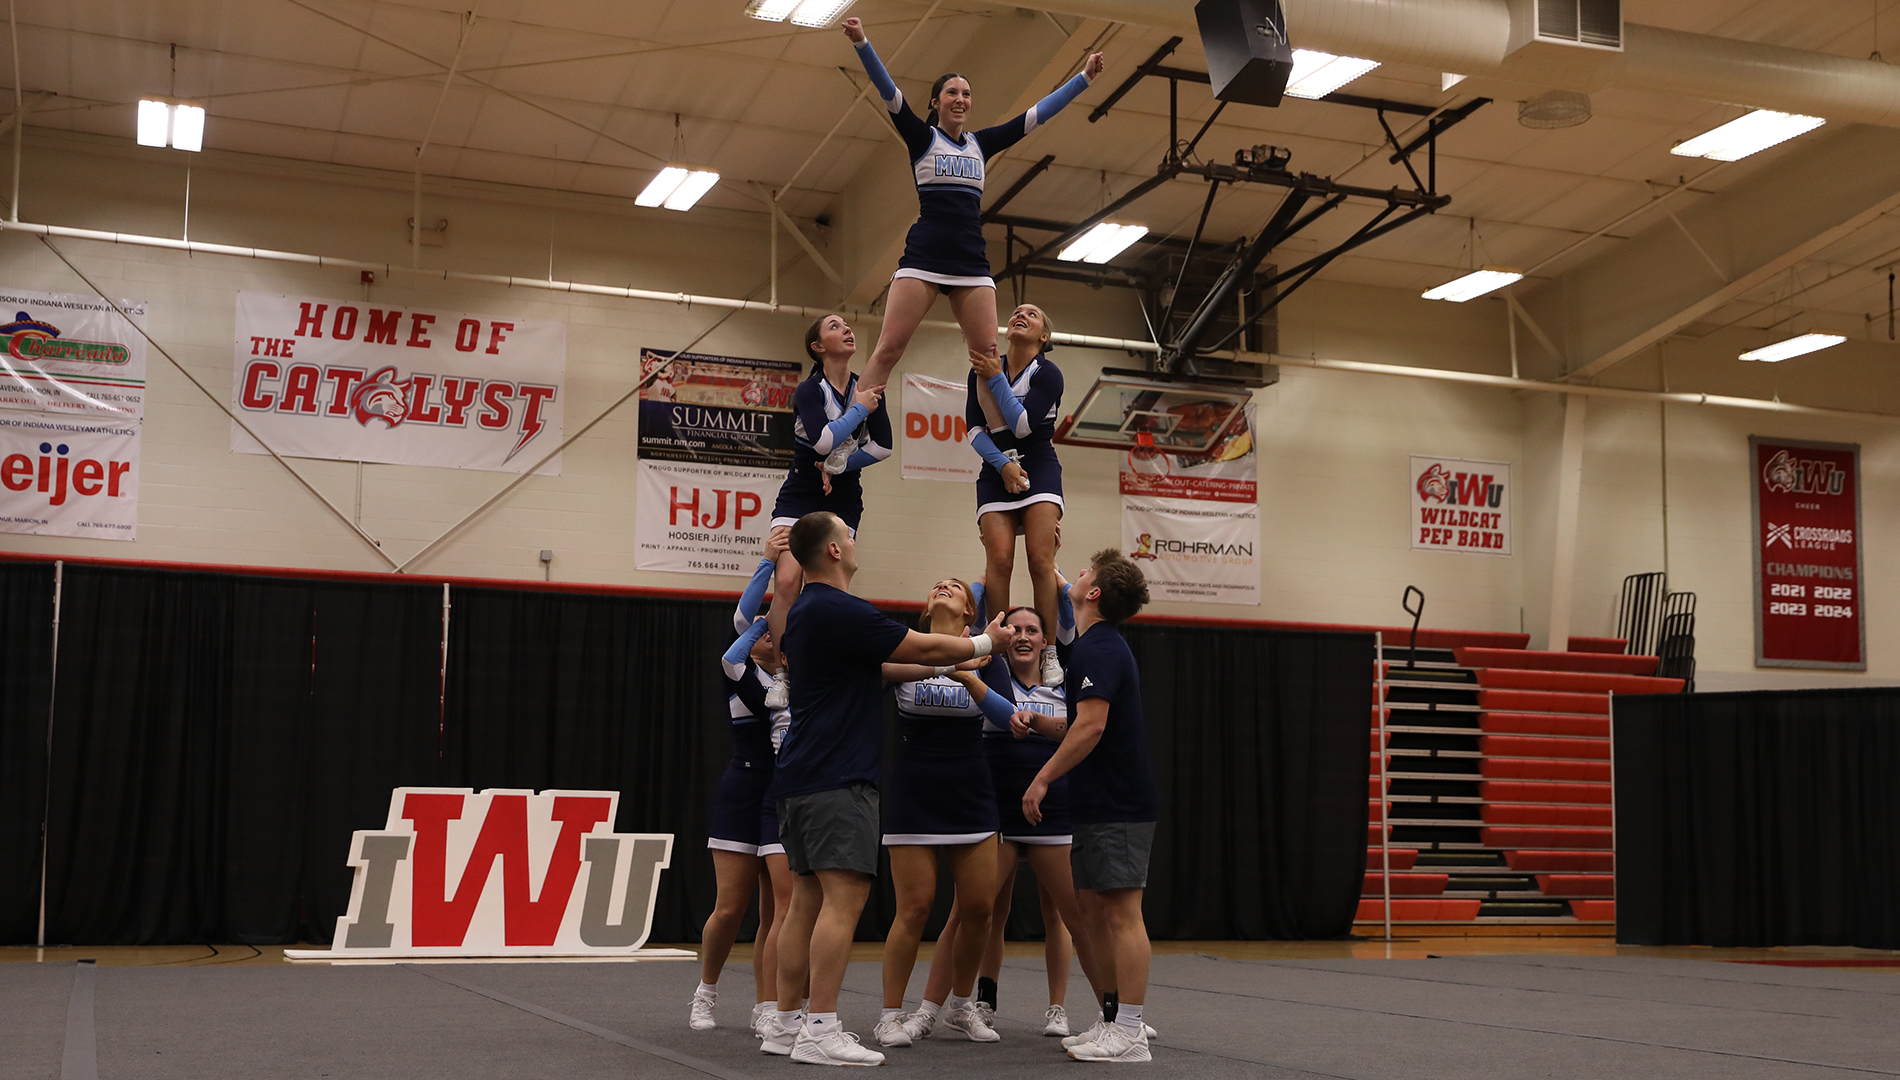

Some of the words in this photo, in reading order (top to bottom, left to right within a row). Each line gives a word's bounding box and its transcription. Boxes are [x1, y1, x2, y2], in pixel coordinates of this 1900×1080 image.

[935, 155, 982, 180] MVNU
[0, 295, 17, 303] SOR
[18, 296, 29, 305] OF
[30, 298, 62, 308] INDIANA
[63, 301, 104, 312] WESLEYAN
[105, 305, 144, 315] ATHETICS
[294, 302, 436, 349] HOME
[455, 318, 514, 355] OF
[8, 332, 125, 361] Charreada
[250, 336, 296, 358] THE
[12, 420, 22, 428] OF
[23, 422, 55, 431] INDIANA
[56, 424, 96, 433] WESLEYAN
[97, 427, 135, 436] ATHLETICS
[671, 406, 773, 433] SUMMIT
[687, 430, 729, 440] FINANCIAL
[731, 433, 758, 442] GROUP
[674, 467, 712, 475] SUPPORTER
[724, 470, 750, 478] WILDCAT
[1793, 459, 1845, 495] IWU
[1447, 472, 1504, 508] IWU
[669, 486, 762, 530] HJP
[1421, 507, 1501, 529] WILDCAT
[668, 531, 710, 542] HOOSIER
[712, 534, 733, 545] Jiffy
[734, 536, 761, 545] PRINT
[1420, 527, 1453, 545] PEP
[1458, 530, 1504, 549] BAND
[1794, 526, 1853, 543] CROSSROADS
[1155, 540, 1252, 556] ROHRMAN
[1794, 541, 1836, 550] LEAGUE
[688, 561, 740, 570] 765.664.3162
[1159, 553, 1217, 564] AUTOMOTIVE
[1222, 556, 1253, 566] GROUP
[1766, 562, 1853, 580] CHAMPIONS
[1771, 584, 1806, 598] 2021
[1814, 586, 1852, 600] 2022
[1770, 602, 1807, 616] 2023
[1814, 604, 1853, 618] 2024
[915, 682, 970, 710] MVNU
[345, 793, 667, 948] IWU
